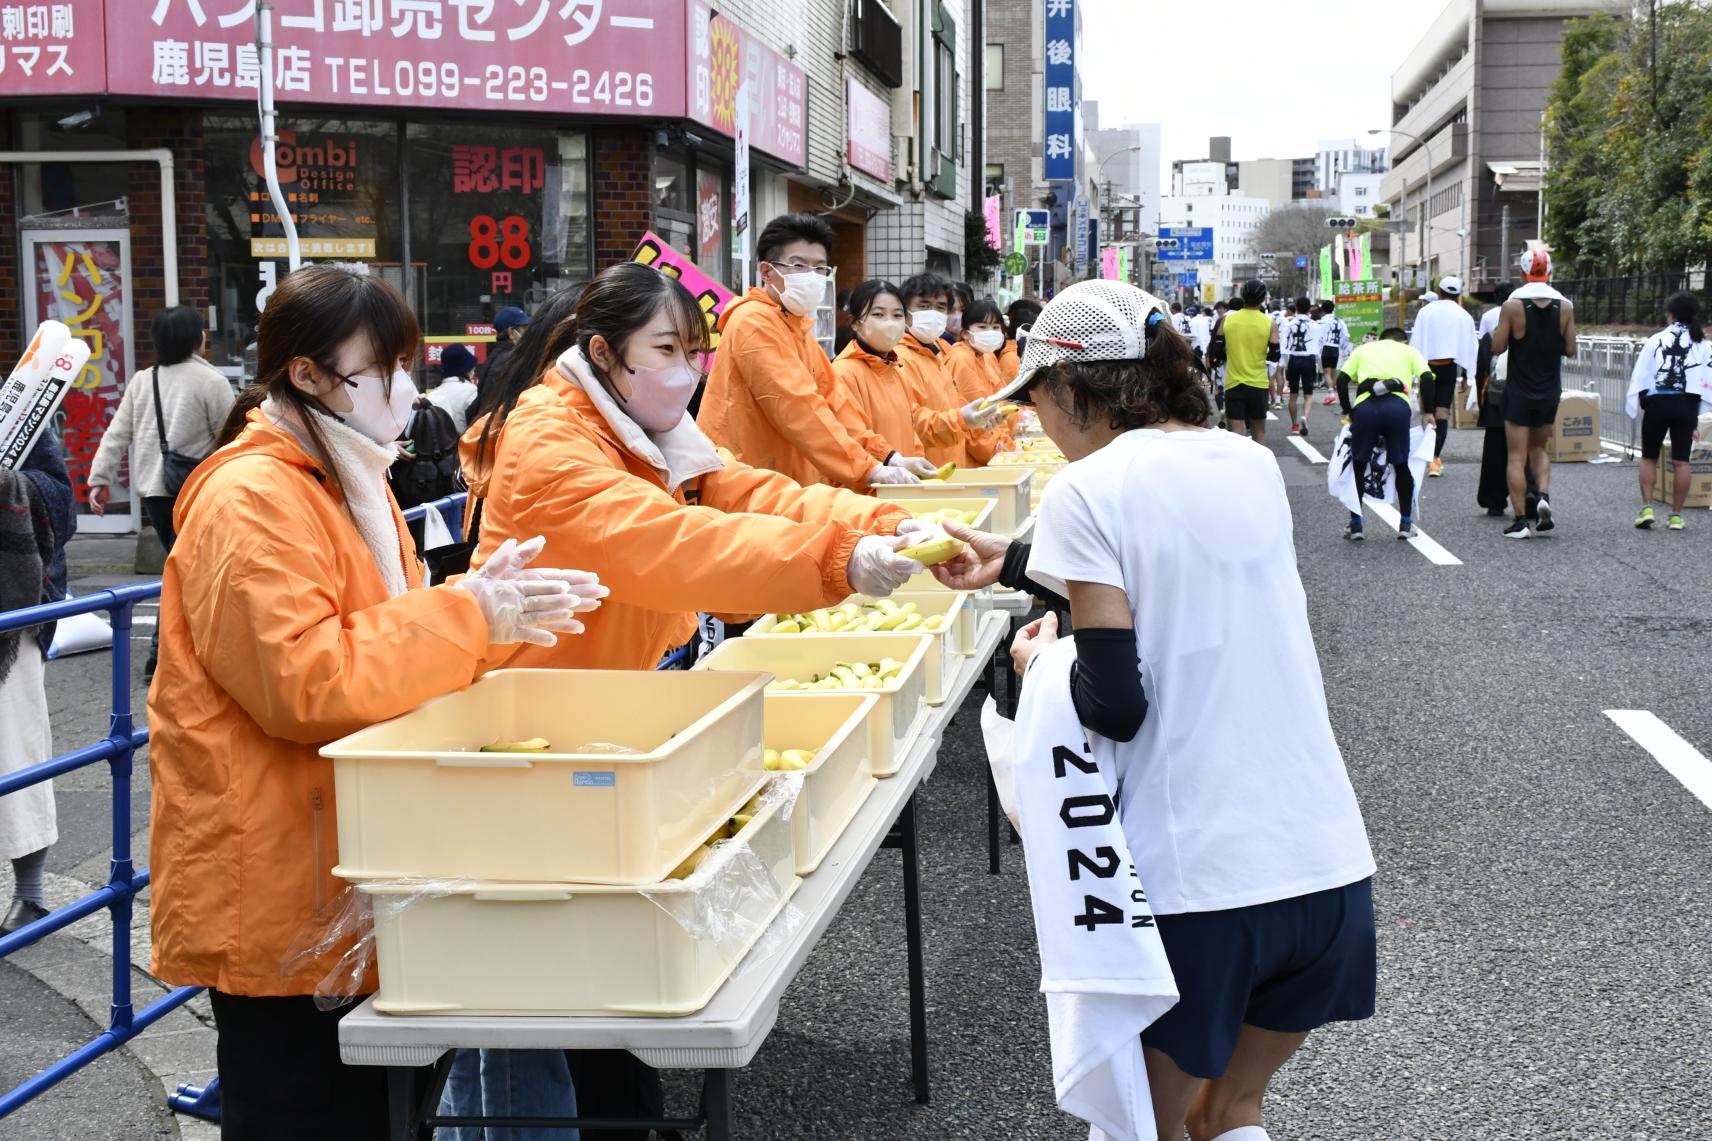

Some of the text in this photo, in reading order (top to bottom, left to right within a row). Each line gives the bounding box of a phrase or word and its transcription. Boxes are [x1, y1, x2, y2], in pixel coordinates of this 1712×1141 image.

[152, 38, 654, 108] 鹿児島店 TEL099-223-2426
[300, 168, 354, 181] Design
[300, 179, 354, 191] Office
[452, 145, 545, 194] 認印
[468, 214, 531, 269] 88
[491, 271, 512, 294] 円
[1052, 742, 1125, 932] 2024
